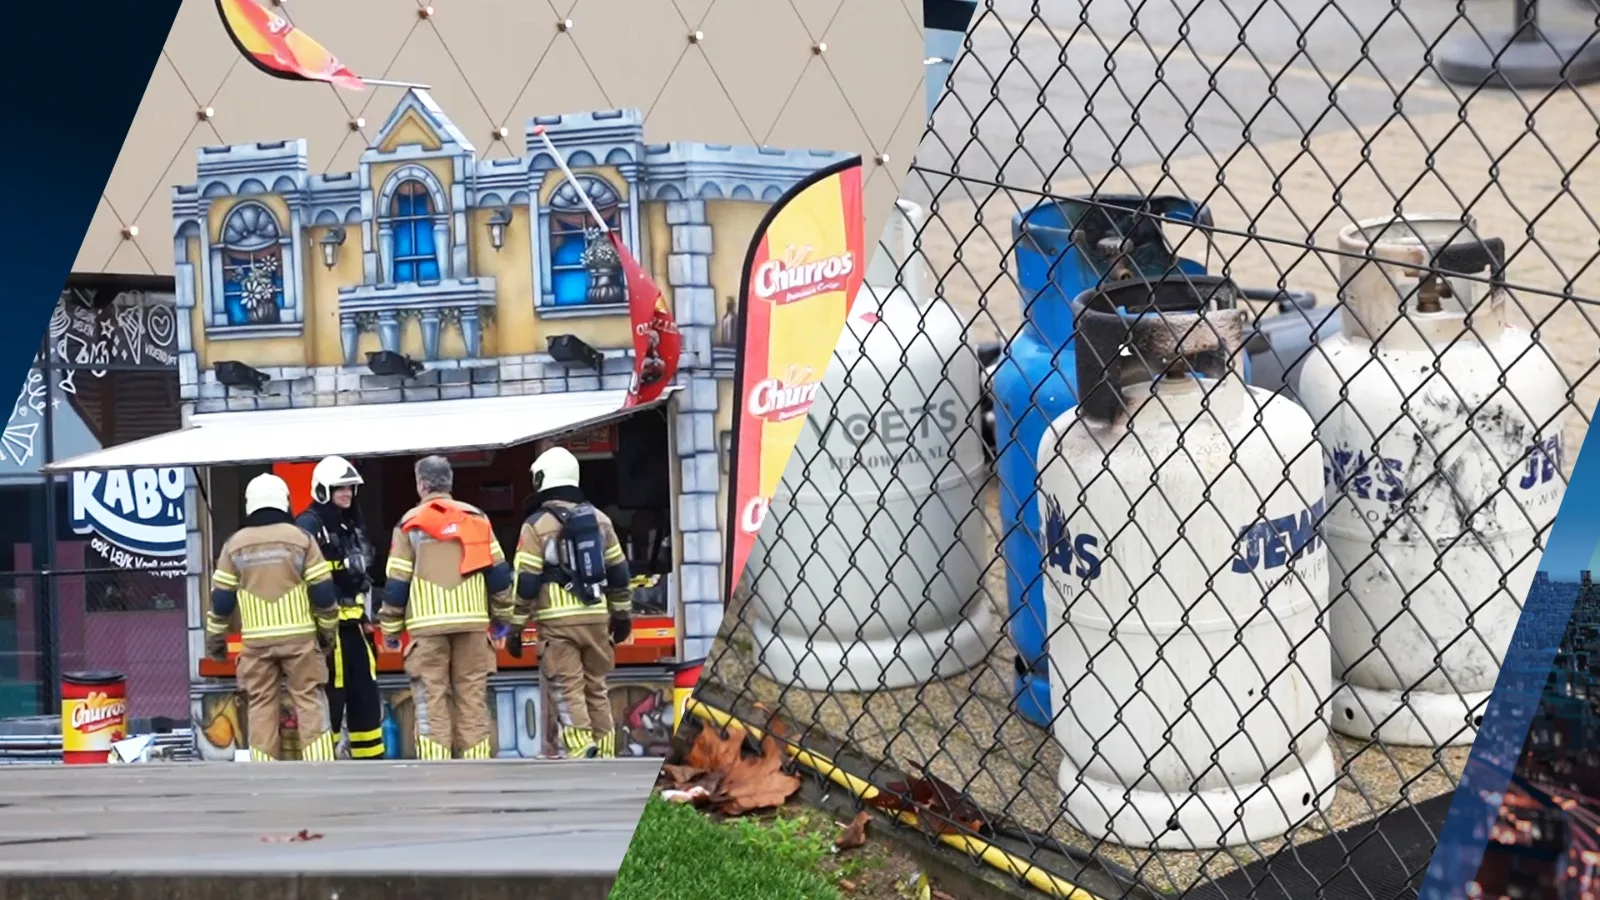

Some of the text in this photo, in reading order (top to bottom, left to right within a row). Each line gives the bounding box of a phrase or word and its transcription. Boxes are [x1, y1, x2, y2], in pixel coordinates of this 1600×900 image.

[755, 252, 853, 297] Churros
[807, 399, 957, 449] VOETS
[71, 701, 126, 729] Churros
